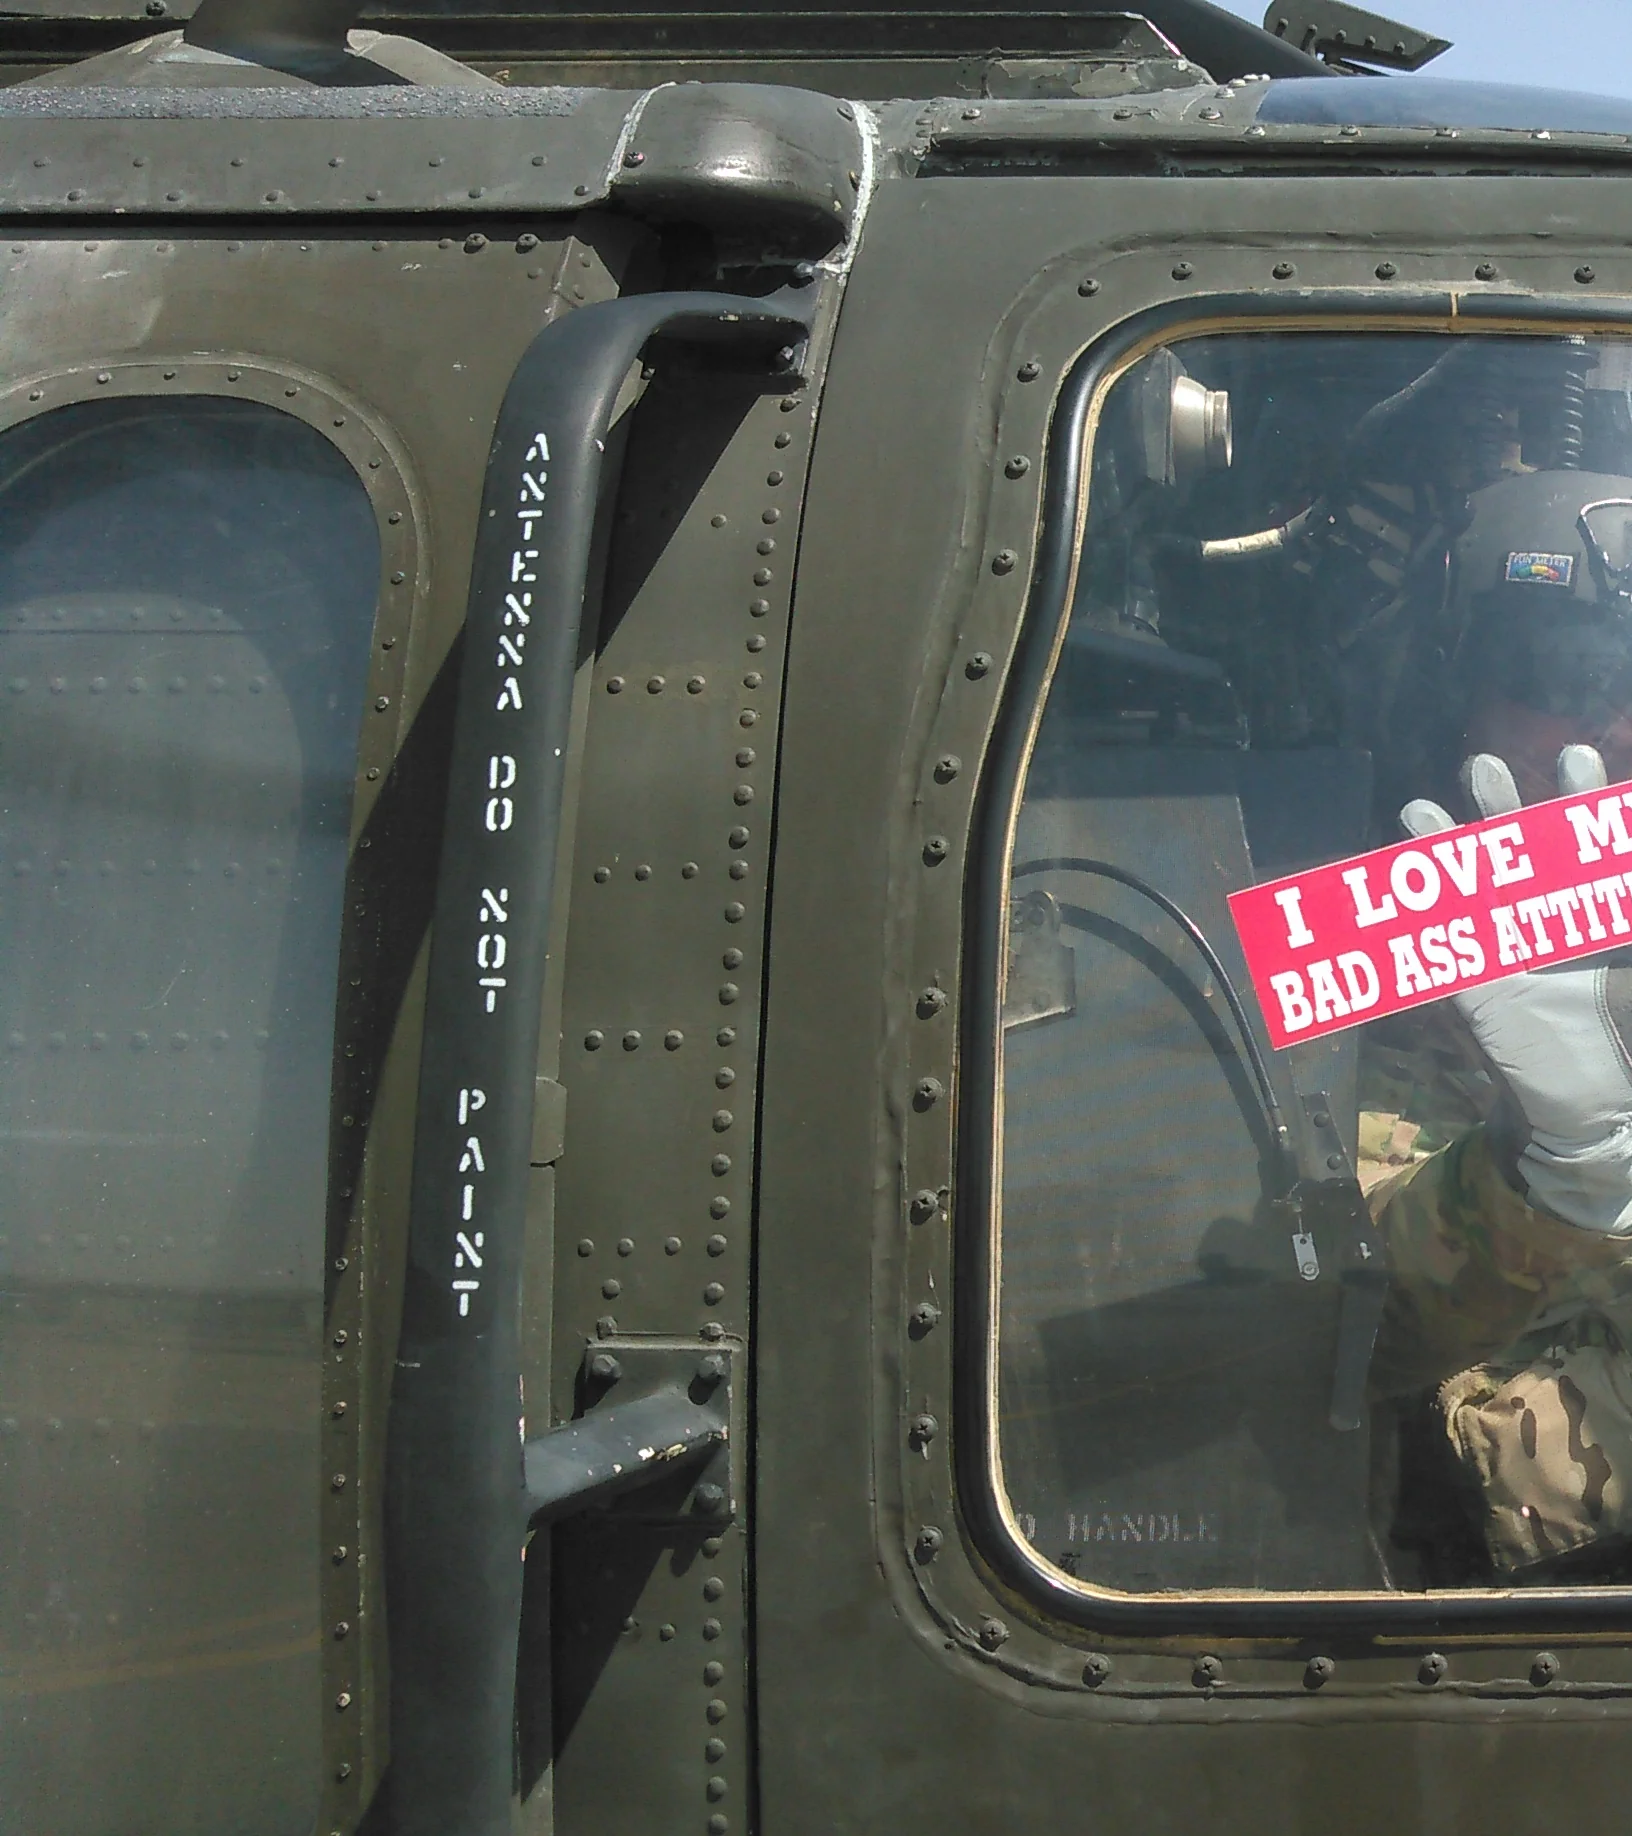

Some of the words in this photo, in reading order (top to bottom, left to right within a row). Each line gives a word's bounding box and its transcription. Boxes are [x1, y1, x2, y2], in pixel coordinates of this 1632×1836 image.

[497, 433, 551, 711] ANTENNA
[486, 755, 516, 832] DO
[1274, 885, 1315, 949] I
[1341, 821, 1535, 930] LOVE
[478, 887, 508, 1013] NOT
[1269, 950, 1381, 1033] BAD
[1387, 915, 1486, 998] ASS
[452, 1088, 486, 1317] PAINT
[1066, 1512, 1219, 1543] HANDLE
